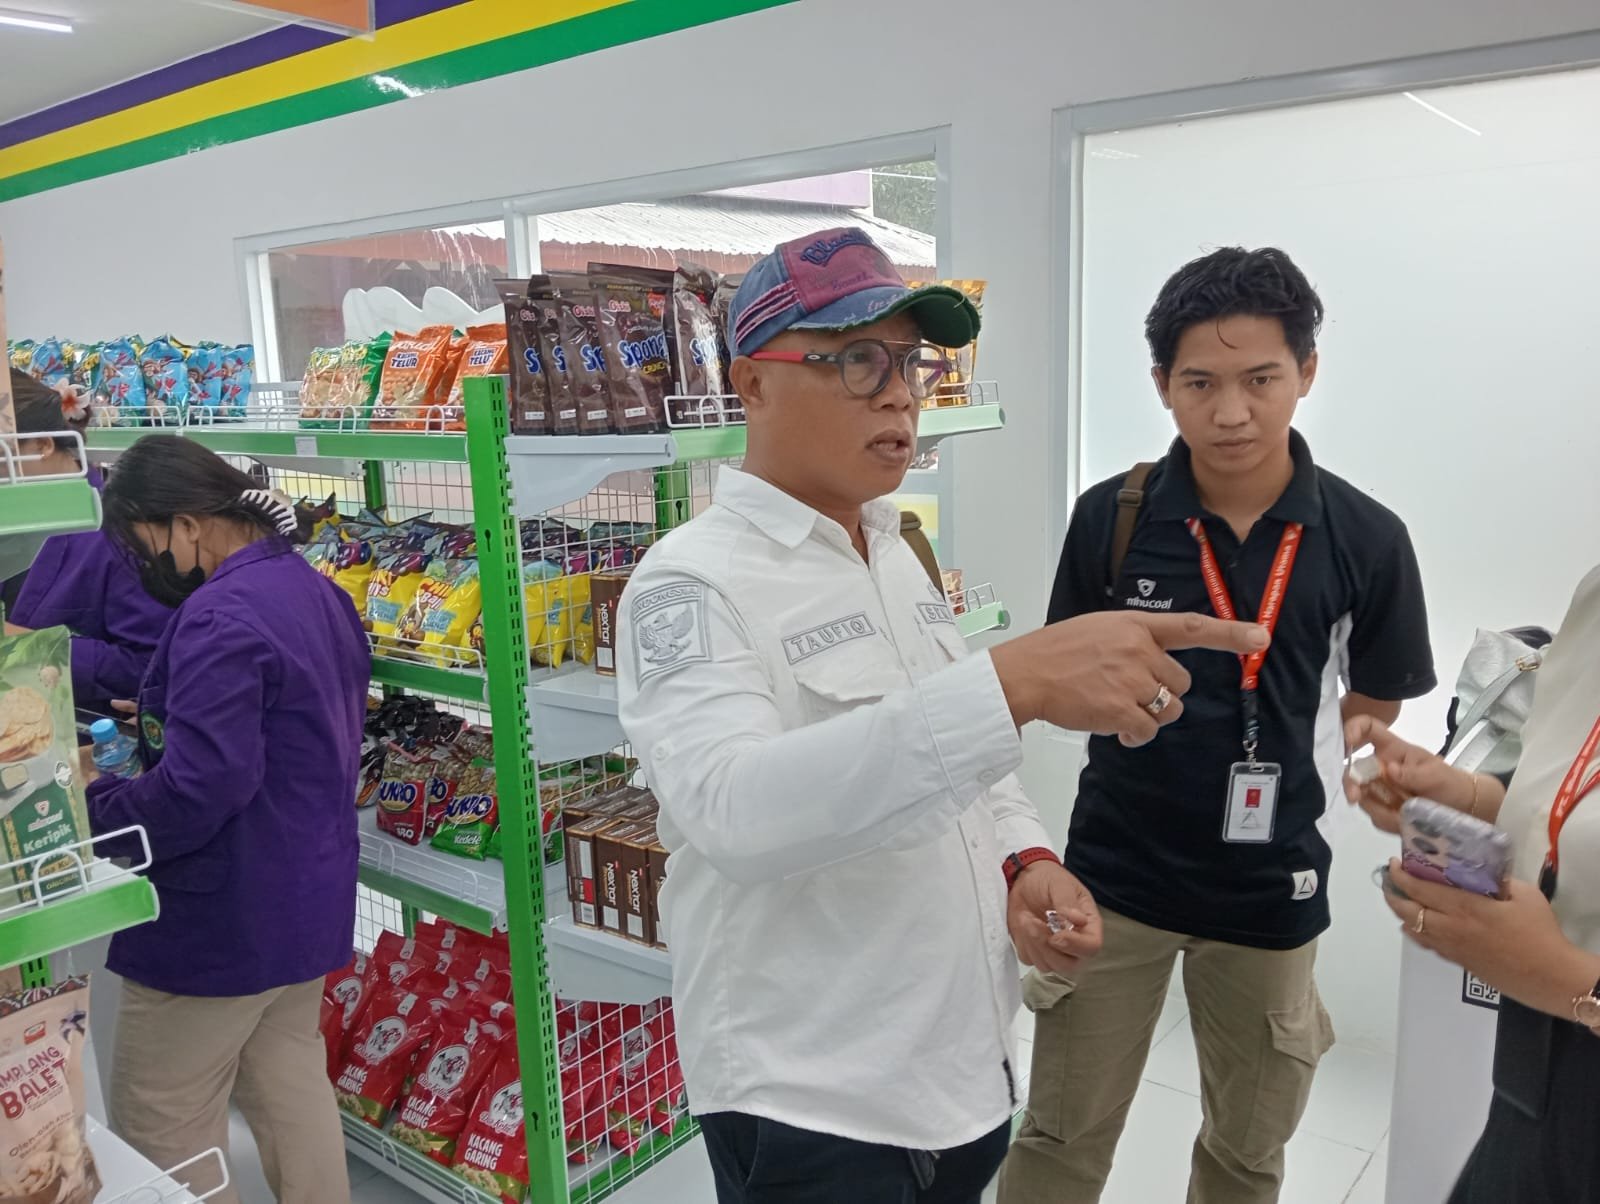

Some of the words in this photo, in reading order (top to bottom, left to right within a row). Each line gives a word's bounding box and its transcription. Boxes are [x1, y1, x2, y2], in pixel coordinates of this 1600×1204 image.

[391, 358, 418, 368] TELUR
[469, 356, 493, 365] TELU
[791, 618, 866, 656] TAUFIQ
[380, 781, 417, 804] UKRO
[23, 824, 73, 855] Keripik
[467, 1133, 504, 1158] KACANG
[464, 1147, 499, 1171] GARING
